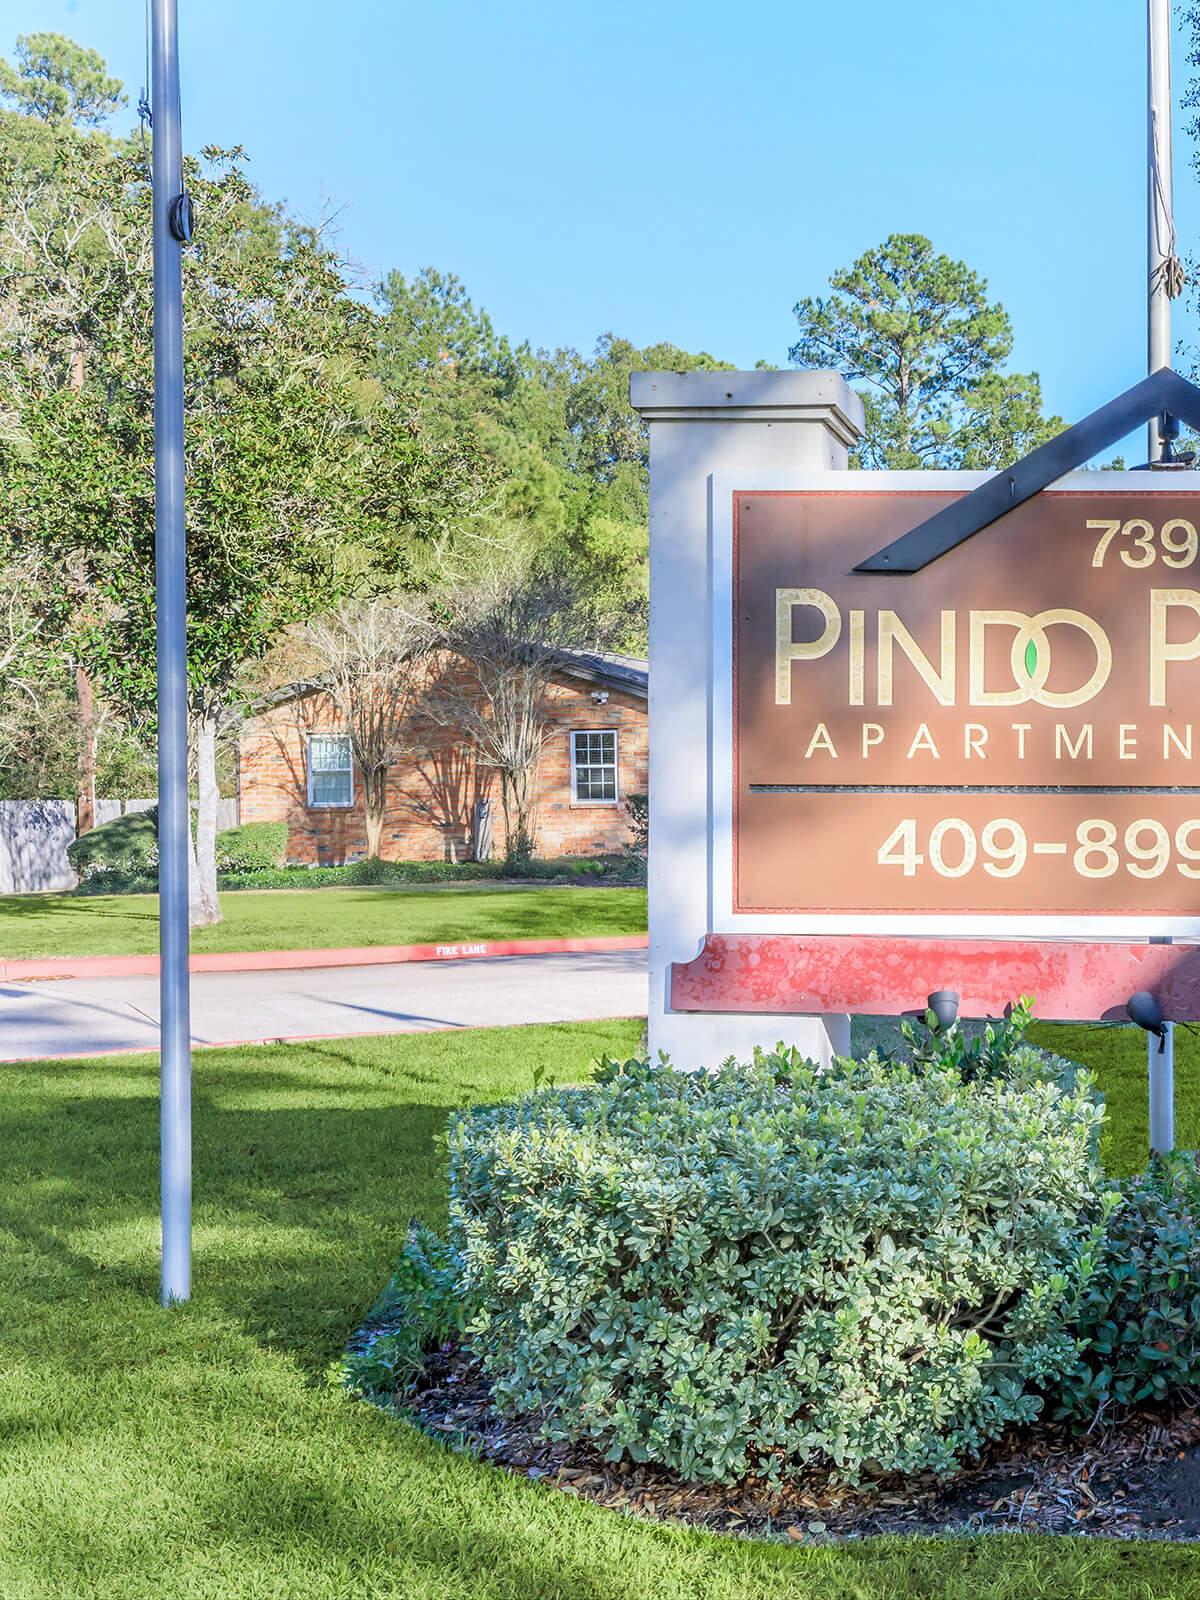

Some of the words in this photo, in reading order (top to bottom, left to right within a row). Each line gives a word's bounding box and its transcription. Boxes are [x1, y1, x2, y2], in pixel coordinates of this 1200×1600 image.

[774, 587, 1112, 709] PINDO
[436, 946, 458, 956] FIRE
[462, 944, 487, 954] LANE
